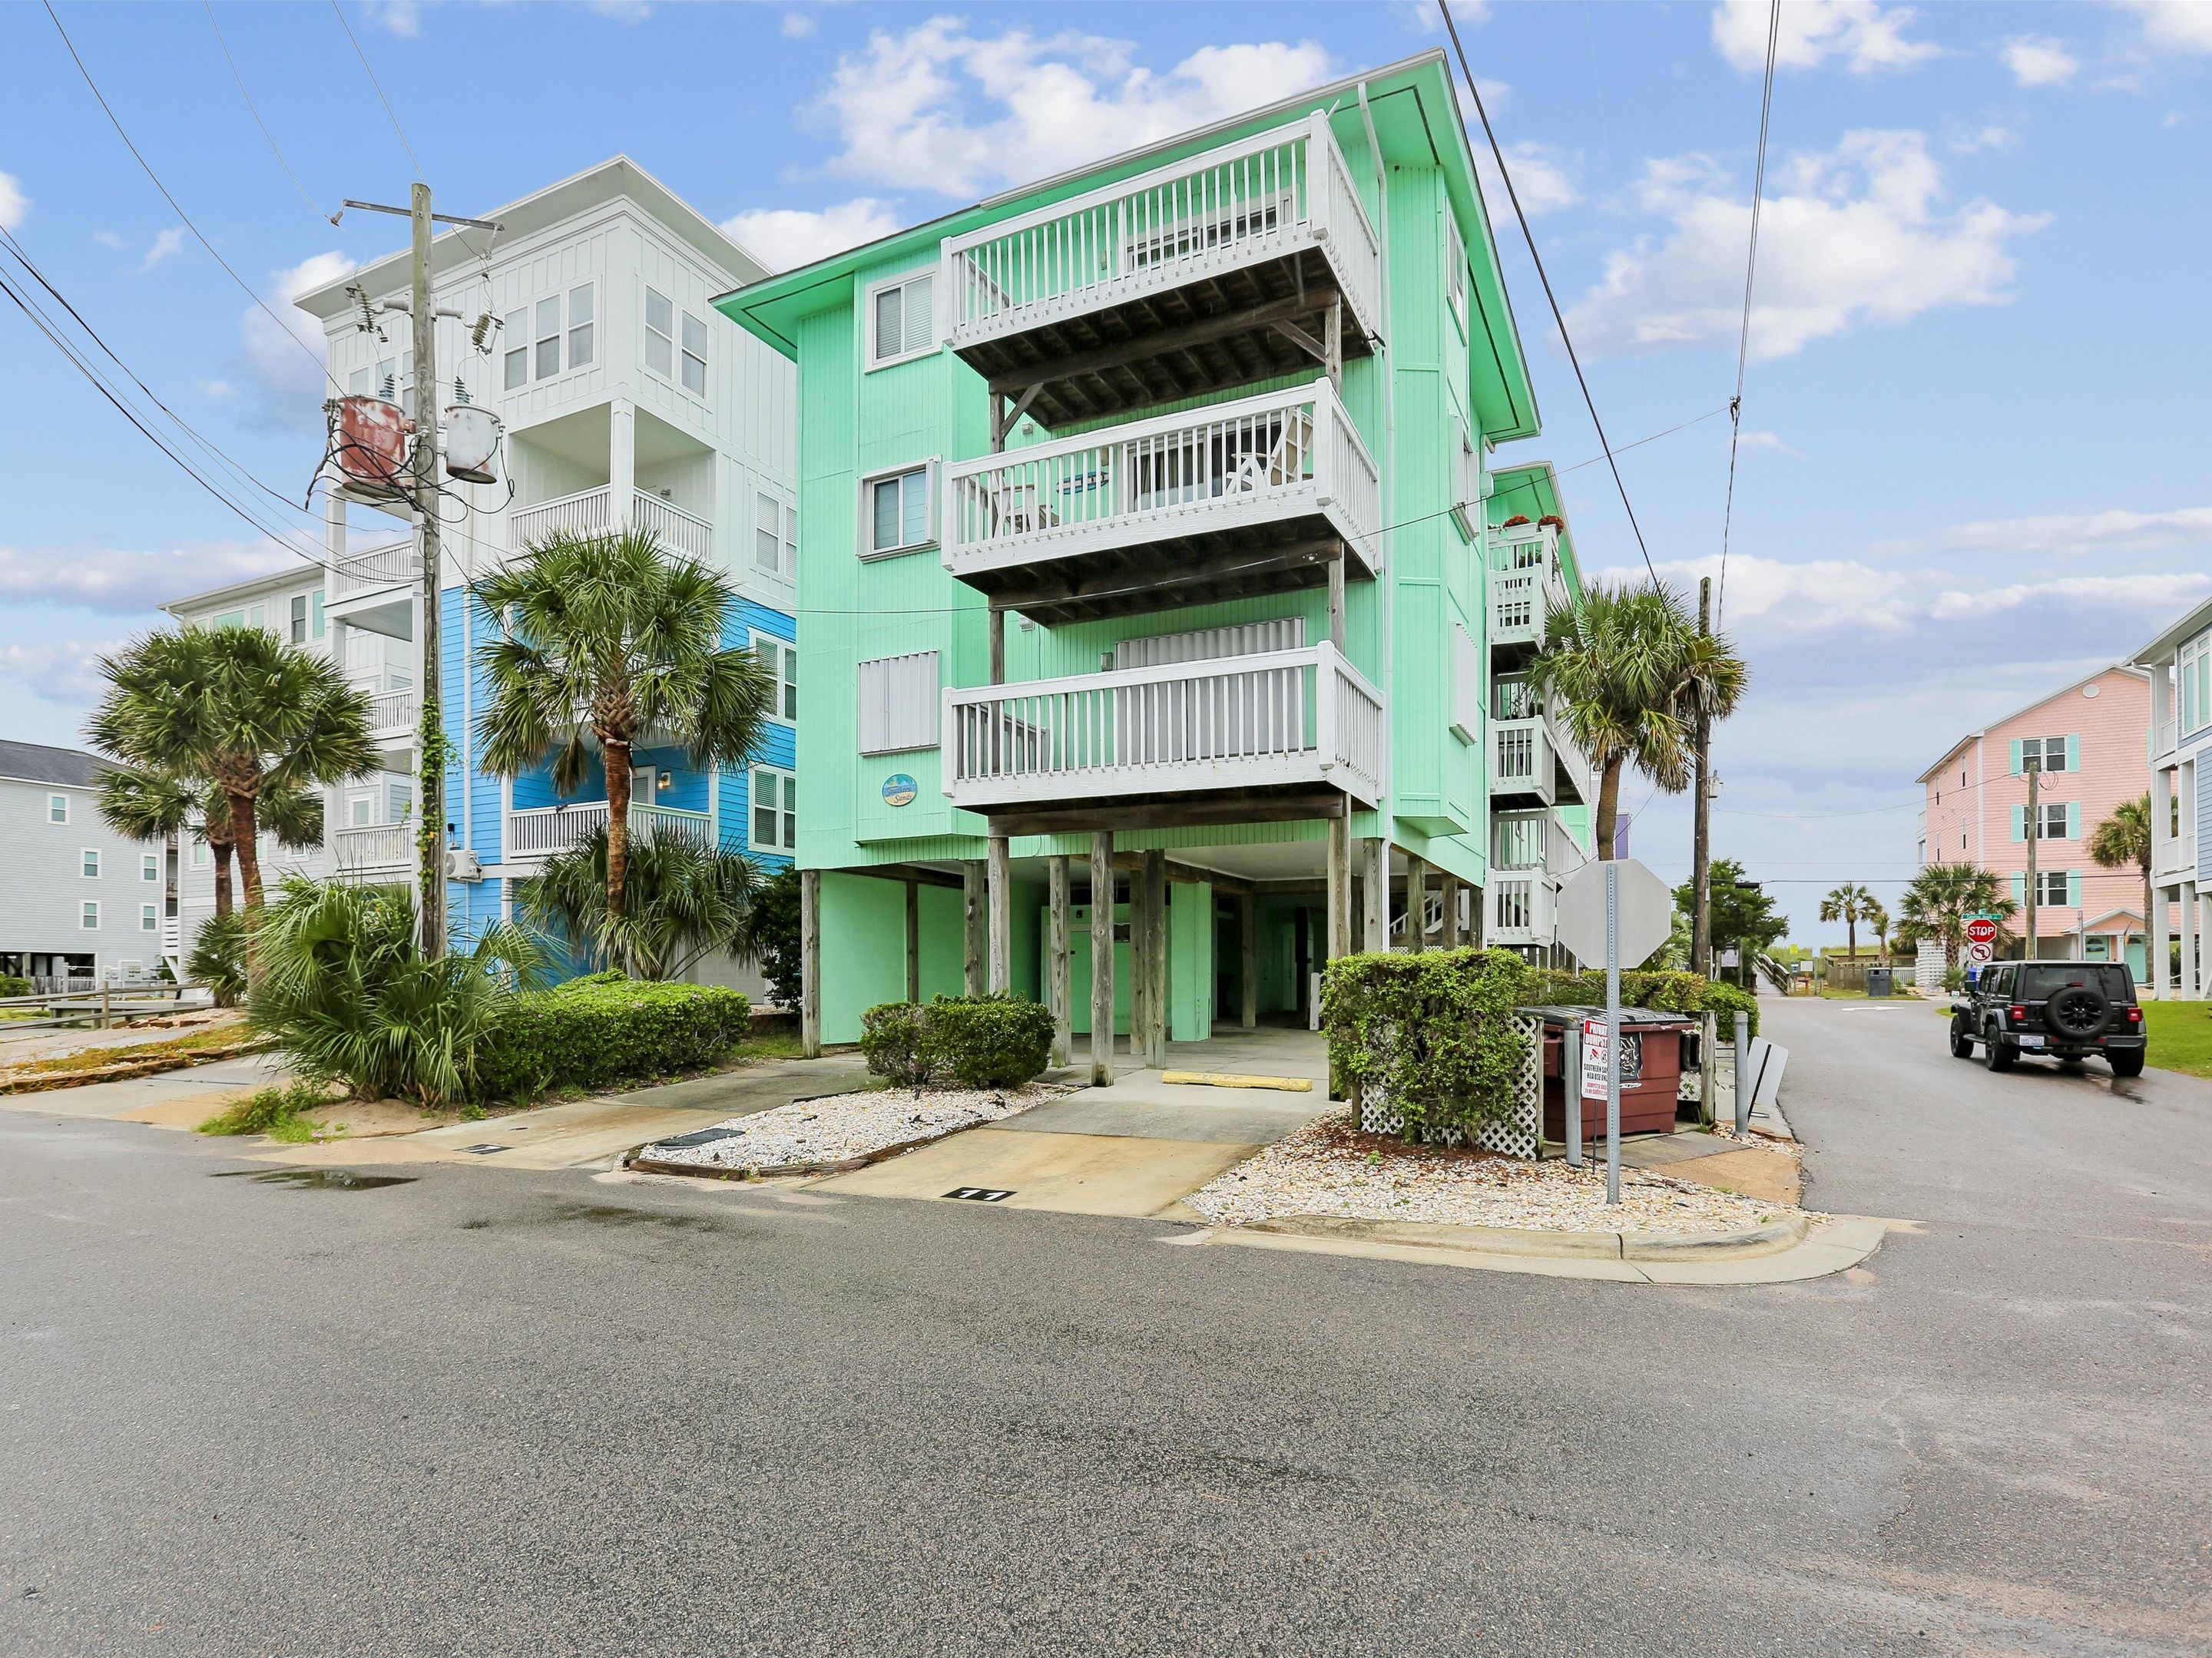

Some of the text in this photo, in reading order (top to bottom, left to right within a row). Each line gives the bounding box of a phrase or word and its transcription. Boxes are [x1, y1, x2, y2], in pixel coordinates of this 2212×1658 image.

[894, 793, 912, 804] Sands
[1969, 926, 1995, 936] STOP
[1589, 1022, 1608, 1037] PRIVAT
[1584, 1033, 1608, 1047] DUMPST
[1584, 1063, 1602, 1073] SOUTHERN
